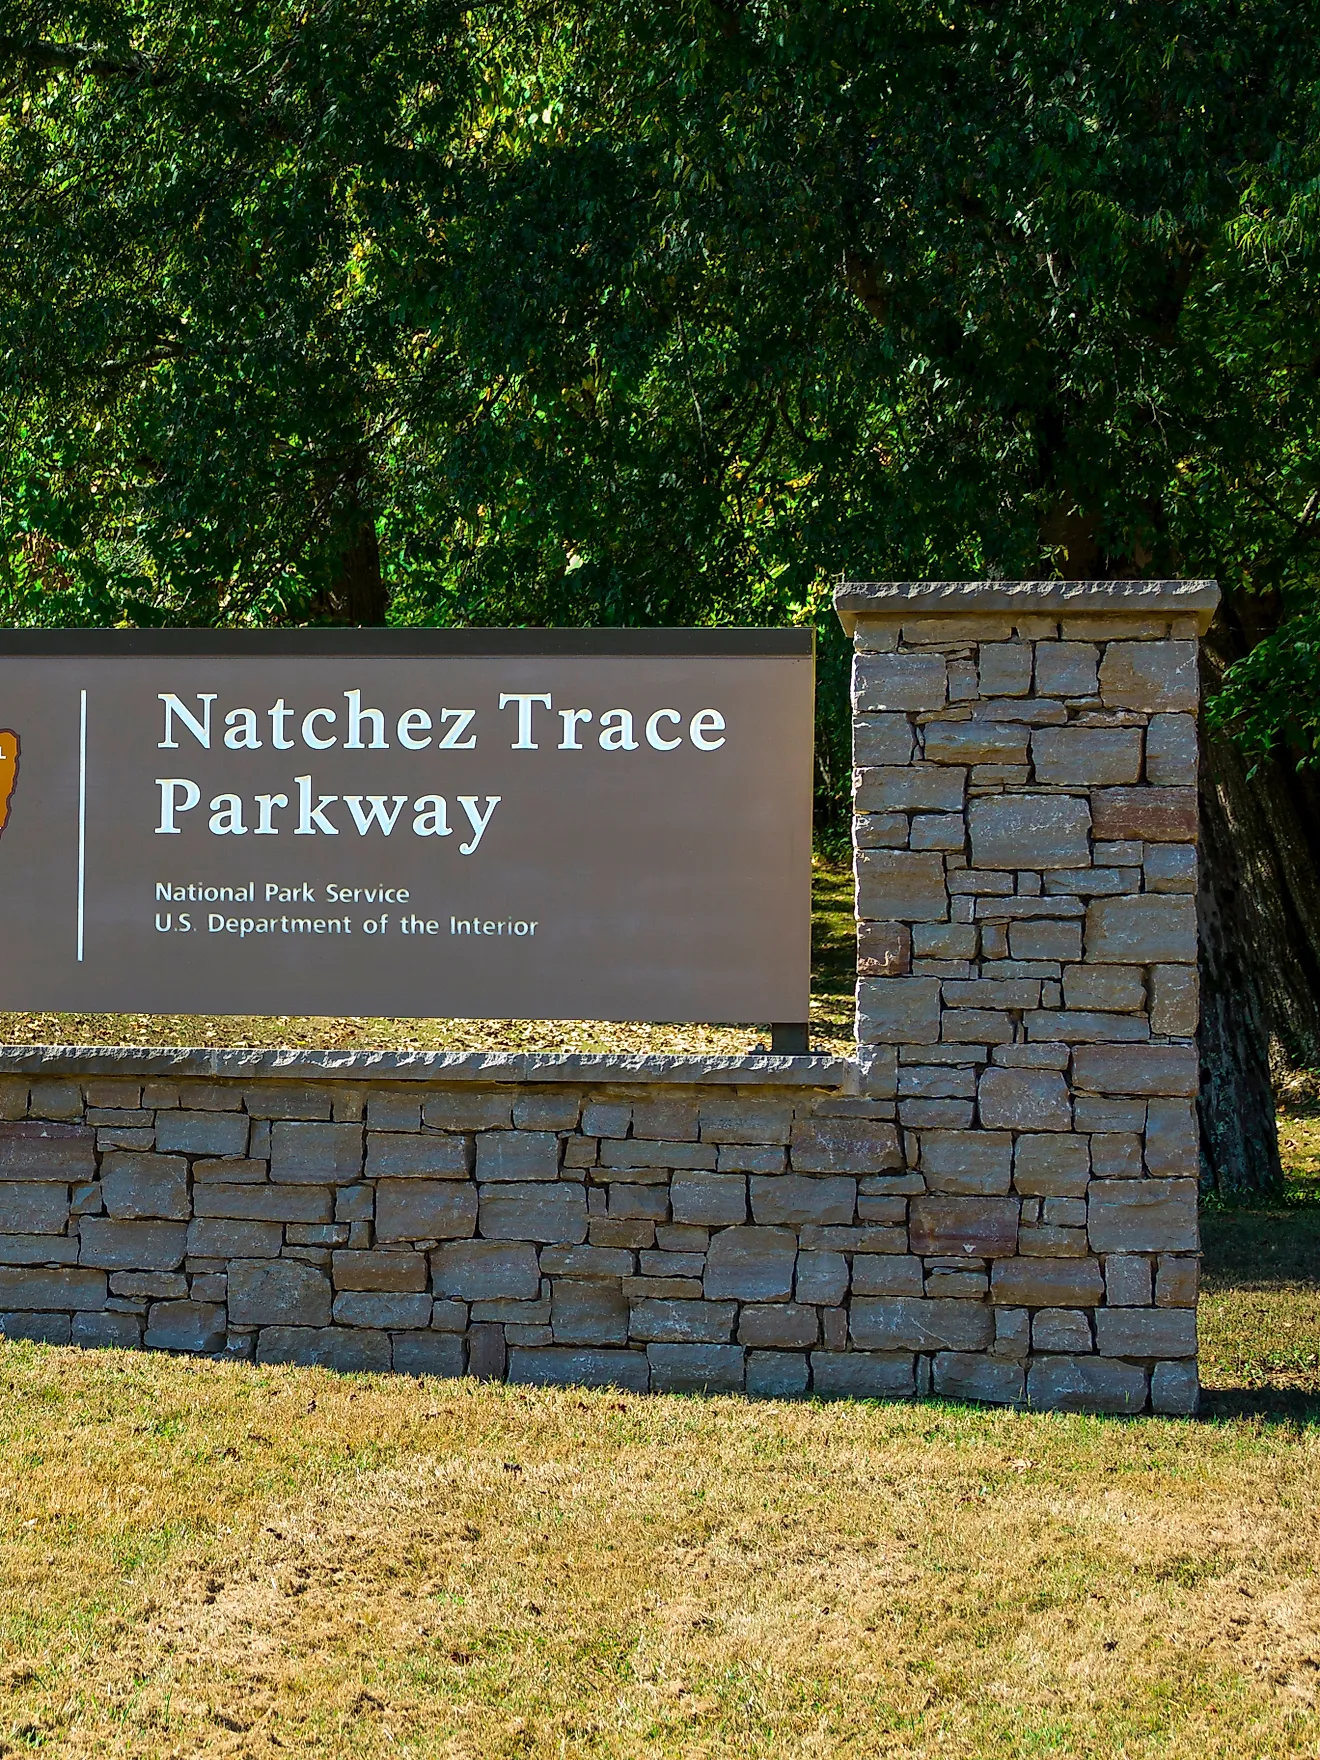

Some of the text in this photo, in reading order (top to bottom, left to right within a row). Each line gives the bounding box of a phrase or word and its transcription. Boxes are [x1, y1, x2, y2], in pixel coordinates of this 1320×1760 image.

[156, 687, 727, 752] Natchez Trace
[154, 774, 502, 856] Parkway
[155, 881, 410, 904] National Park Service
[155, 913, 539, 939] U.S. Department of the Interior
